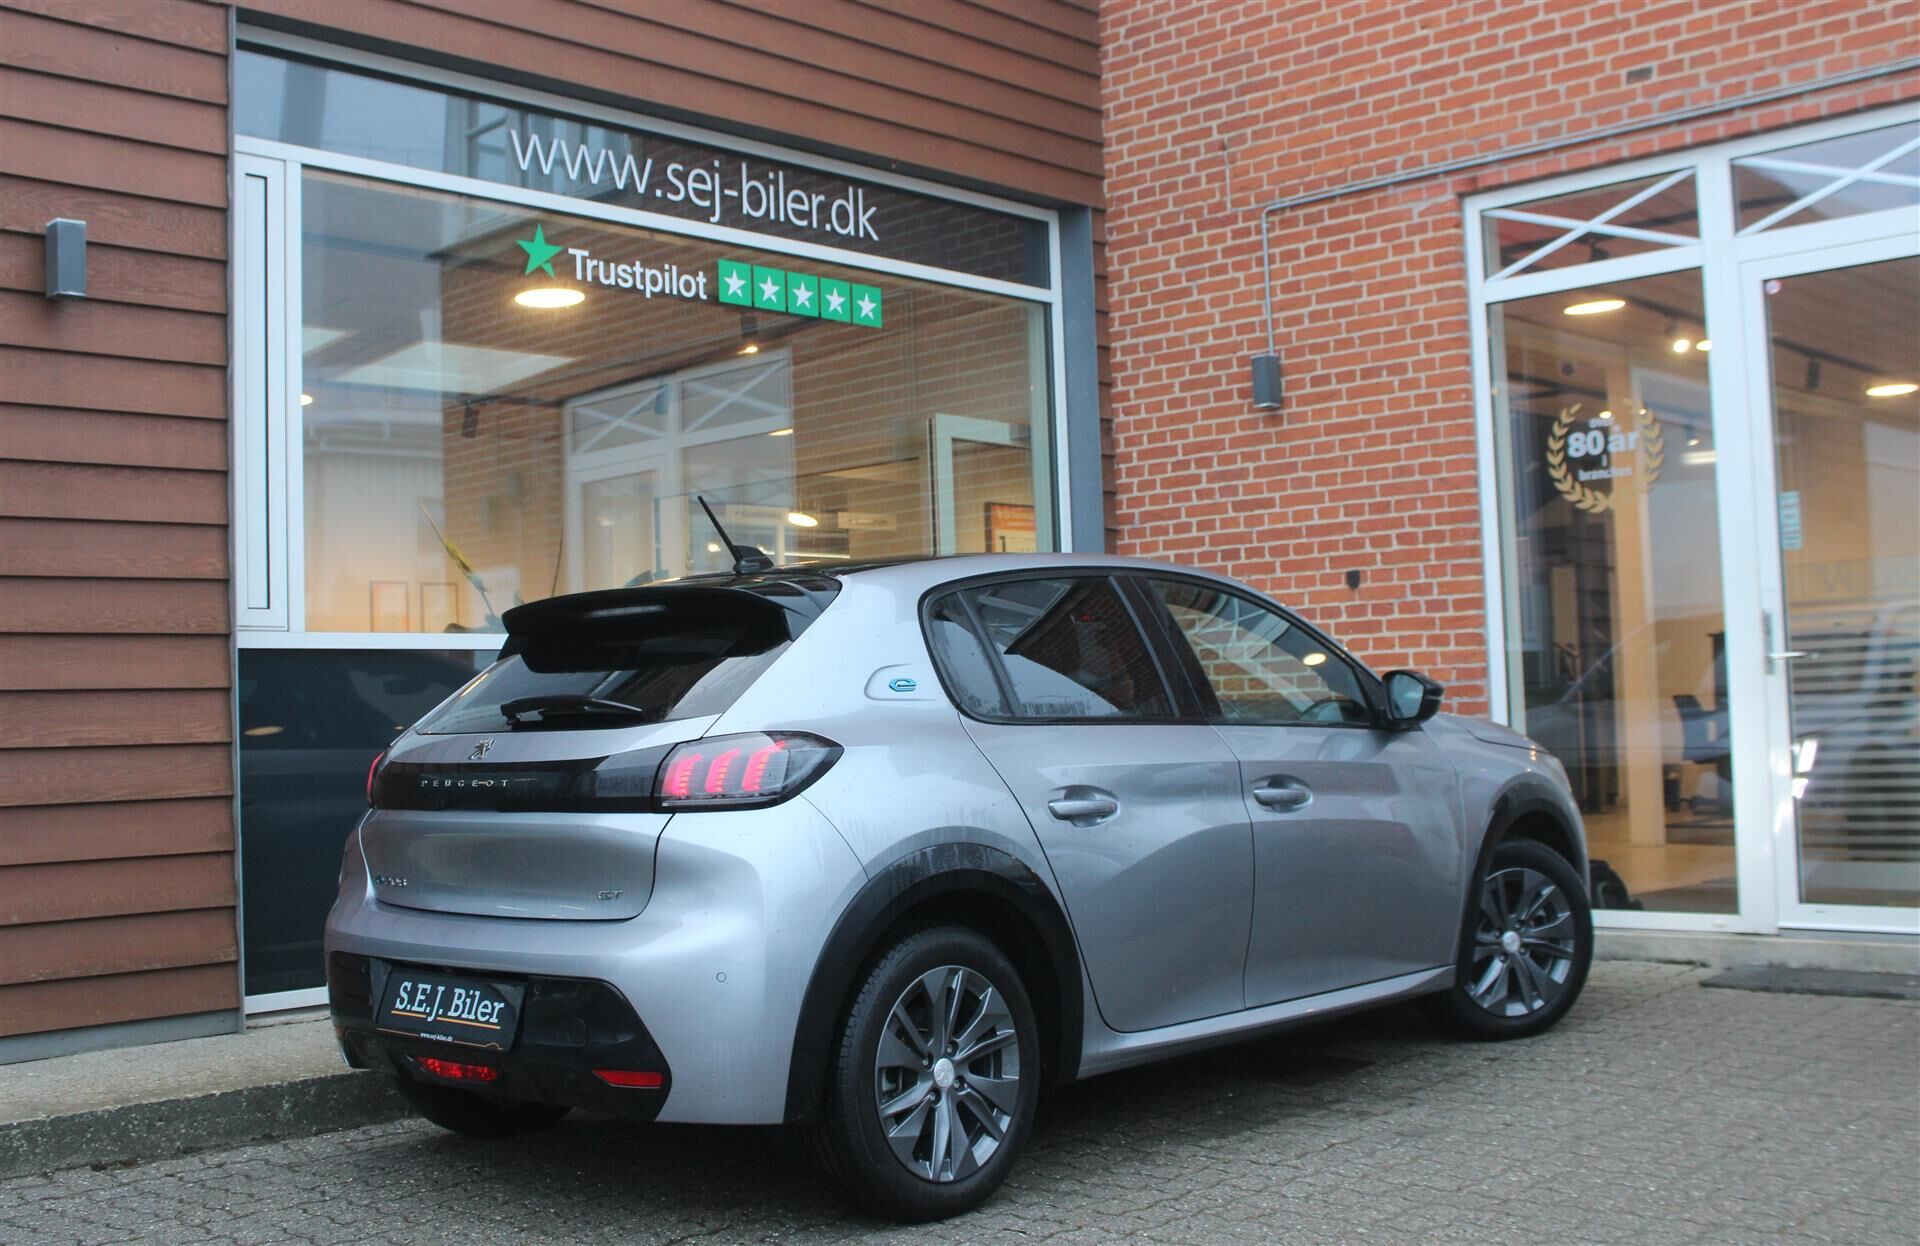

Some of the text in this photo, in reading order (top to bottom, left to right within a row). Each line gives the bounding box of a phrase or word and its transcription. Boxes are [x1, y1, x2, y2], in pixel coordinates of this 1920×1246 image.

[510, 129, 880, 242] www.sej-biler.dk
[568, 248, 708, 300] Trustpilot
[1567, 425, 1638, 458] 80 år
[421, 779, 509, 788] PEUGEOT
[395, 981, 505, 1023] S.E.J. Biler
